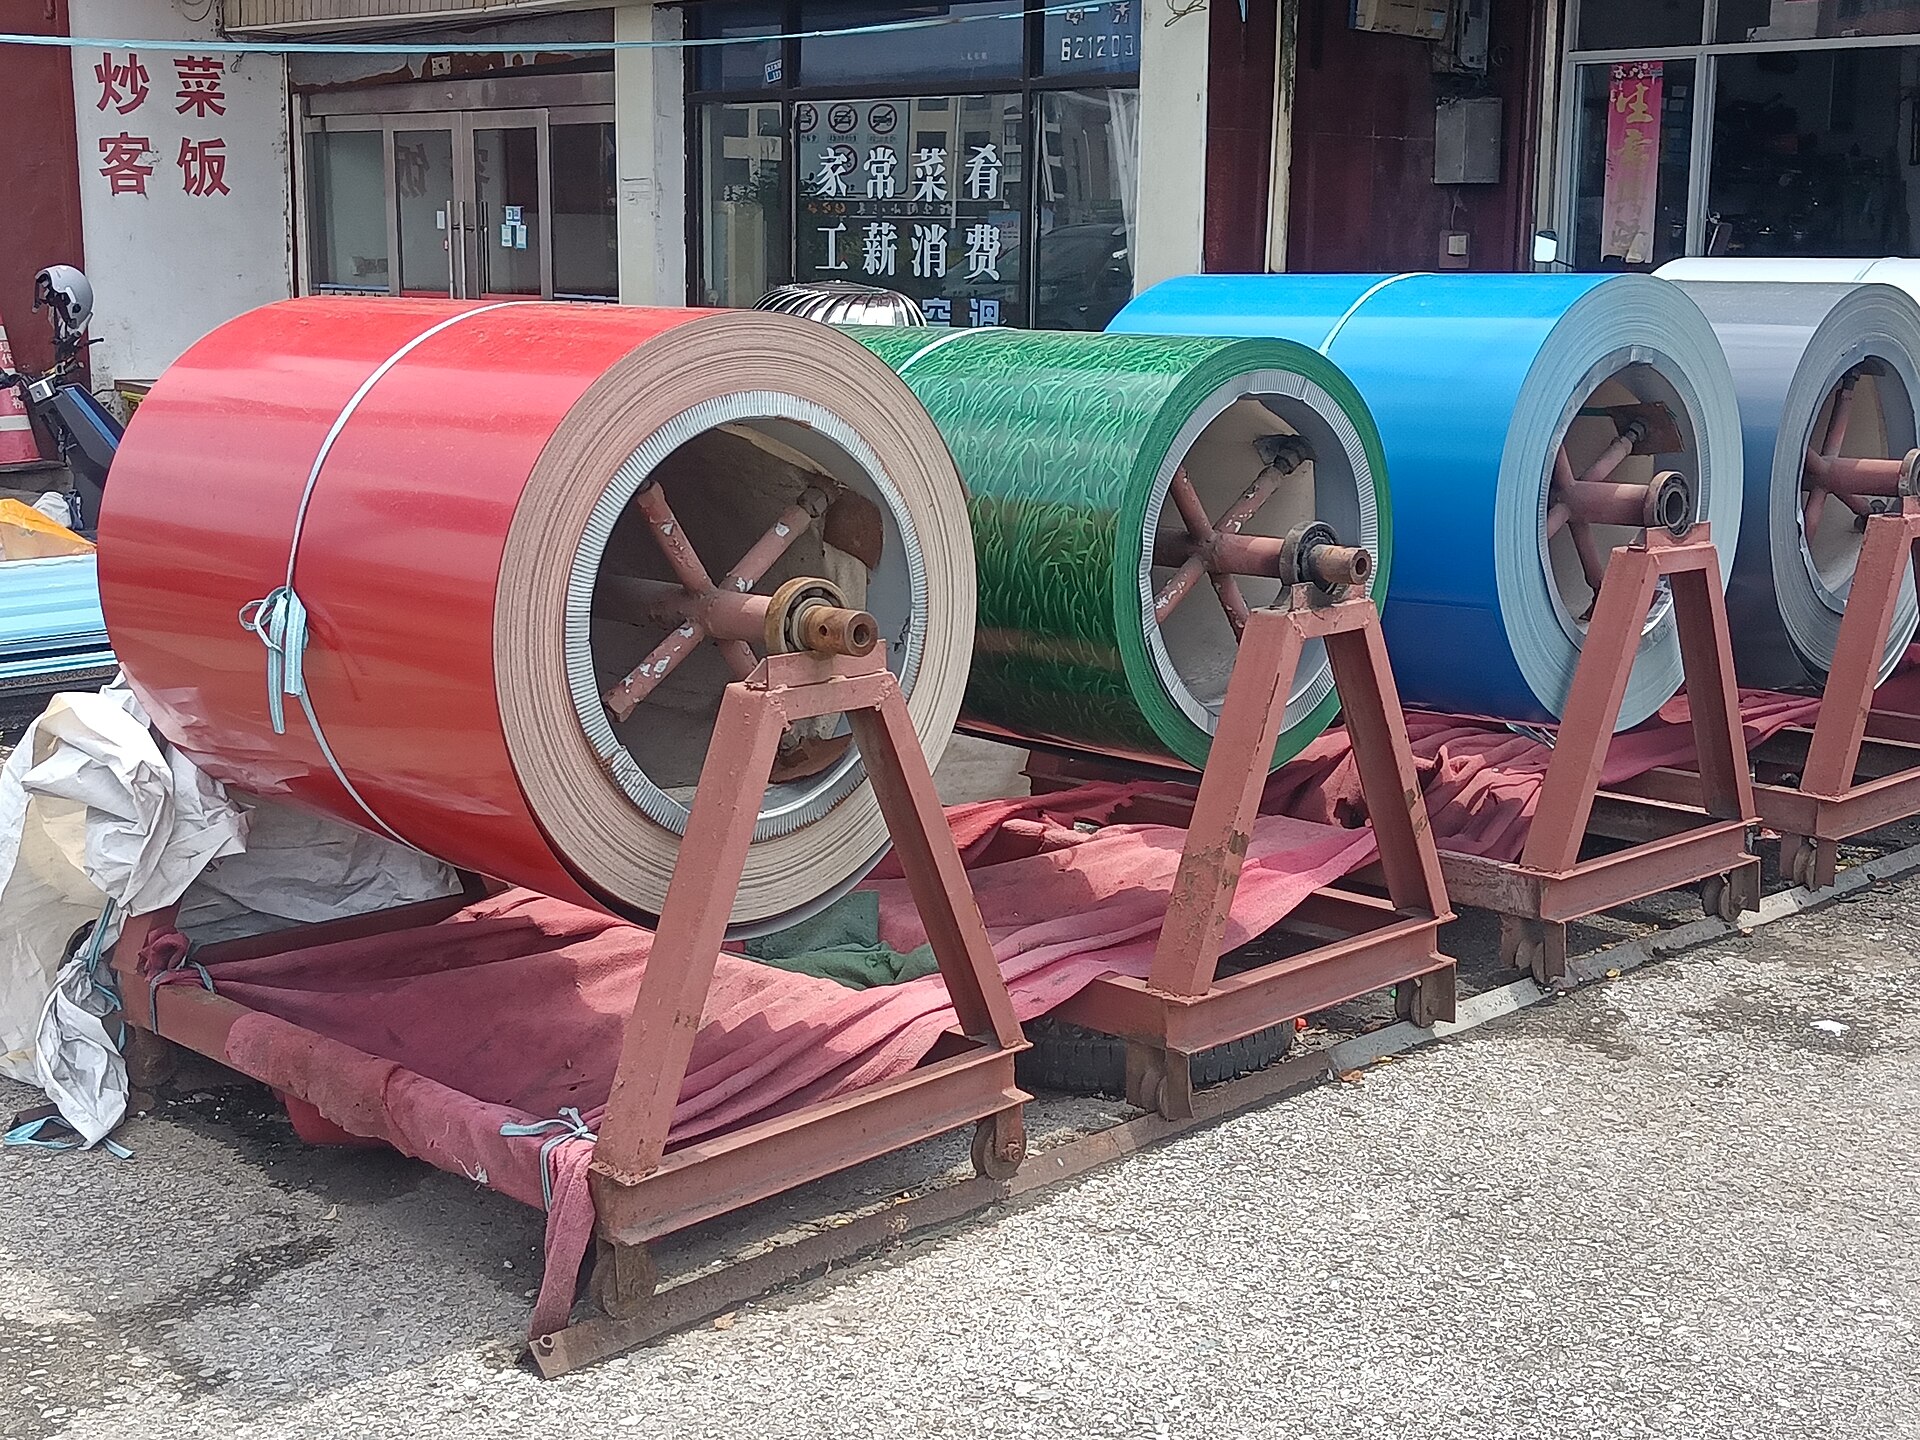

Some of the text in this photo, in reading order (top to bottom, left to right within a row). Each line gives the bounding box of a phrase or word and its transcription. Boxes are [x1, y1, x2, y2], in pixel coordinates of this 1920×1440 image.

[1061, 35, 1134, 60] 621203
[94, 52, 227, 117] 炒菜
[99, 132, 231, 198] 客饭
[815, 143, 1003, 202] 家常菜肴
[1614, 82, 1655, 248] 生意
[814, 222, 1001, 281] 工薪消费
